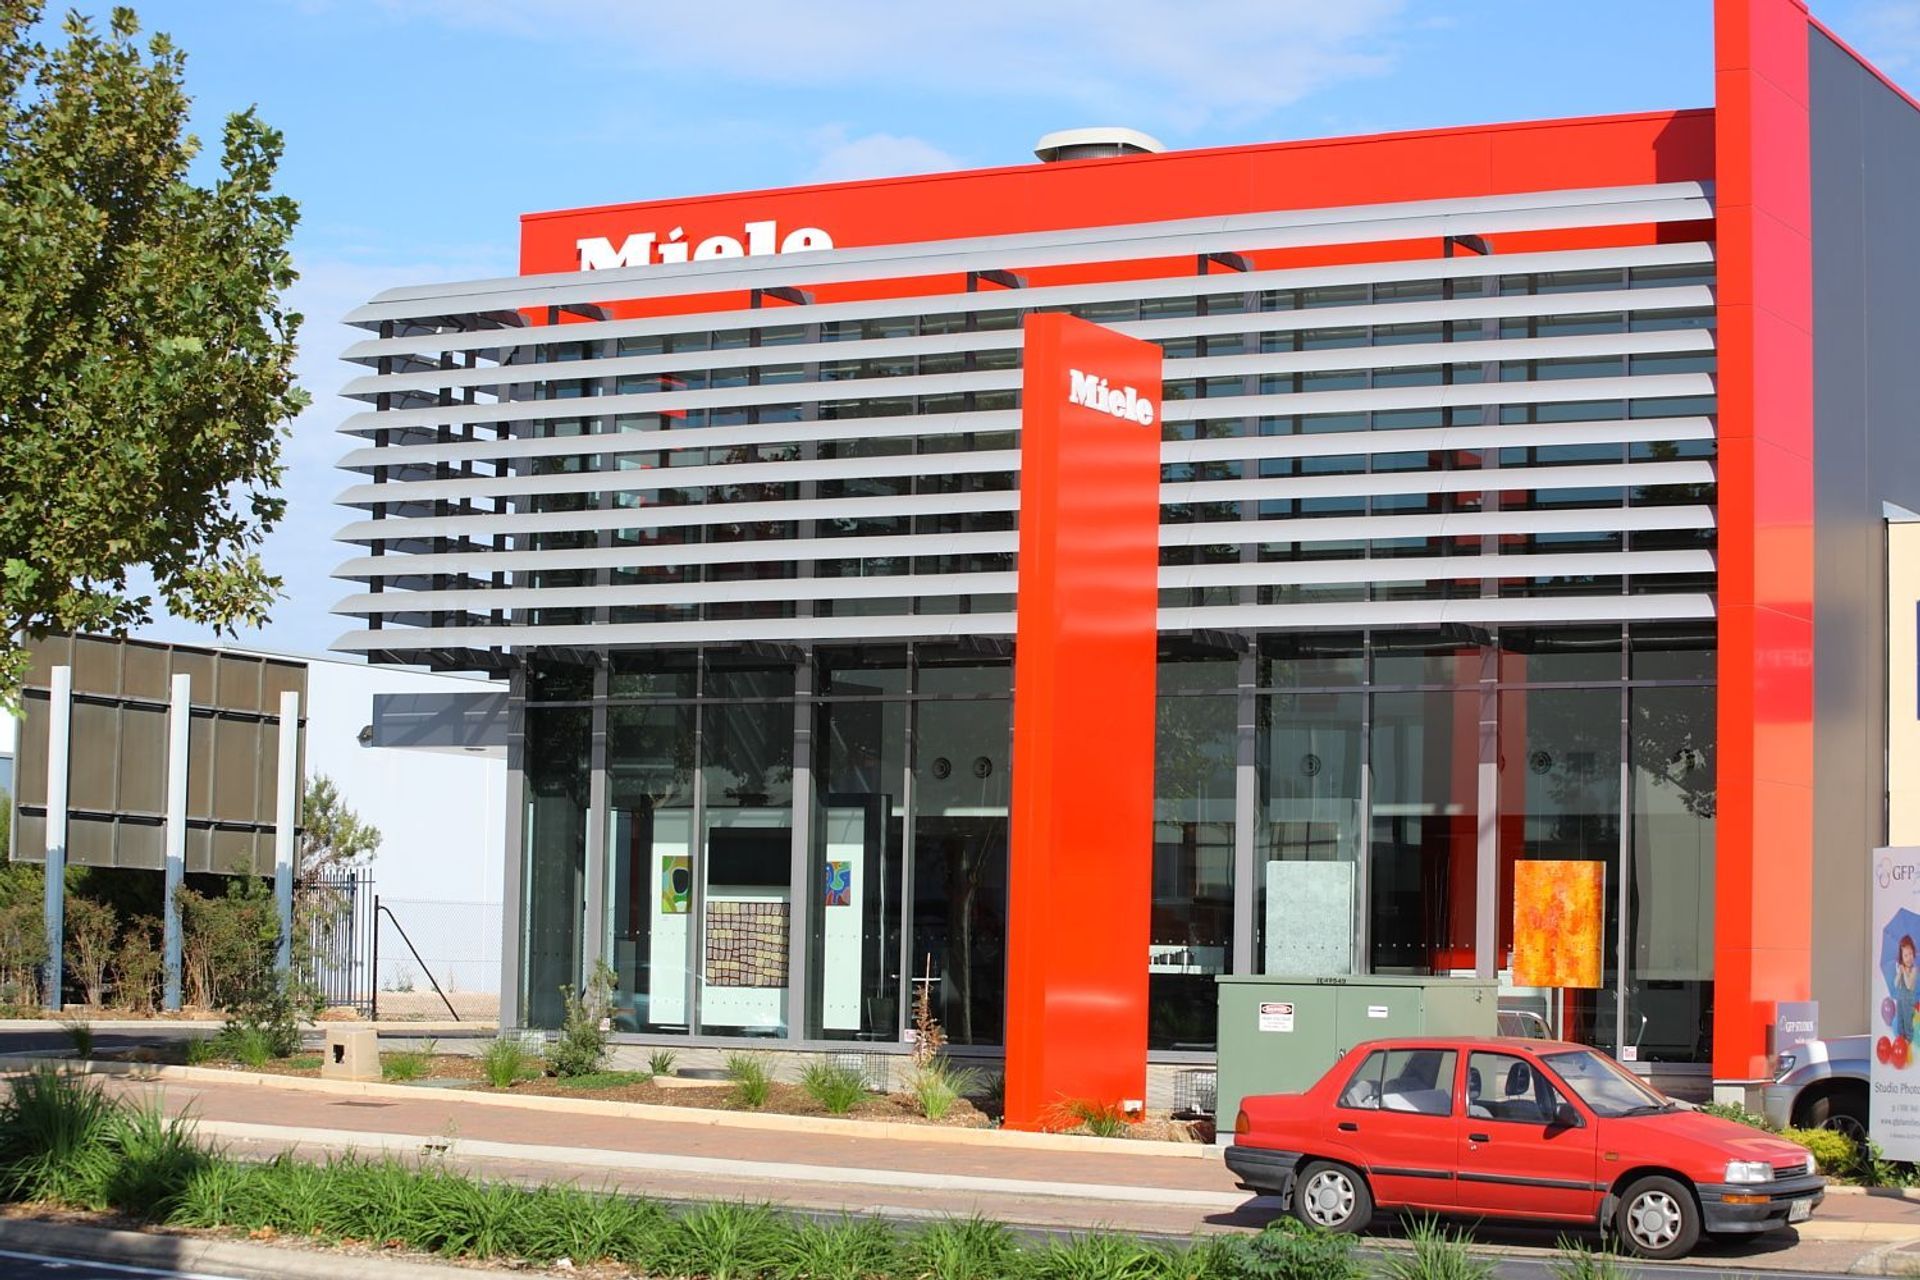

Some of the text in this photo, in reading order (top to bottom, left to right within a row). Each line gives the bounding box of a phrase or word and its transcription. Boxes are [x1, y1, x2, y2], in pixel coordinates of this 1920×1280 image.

[1069, 368, 1154, 426] Miele
[1892, 865, 1915, 880] GFP
[1874, 1081, 1899, 1094] Studio
